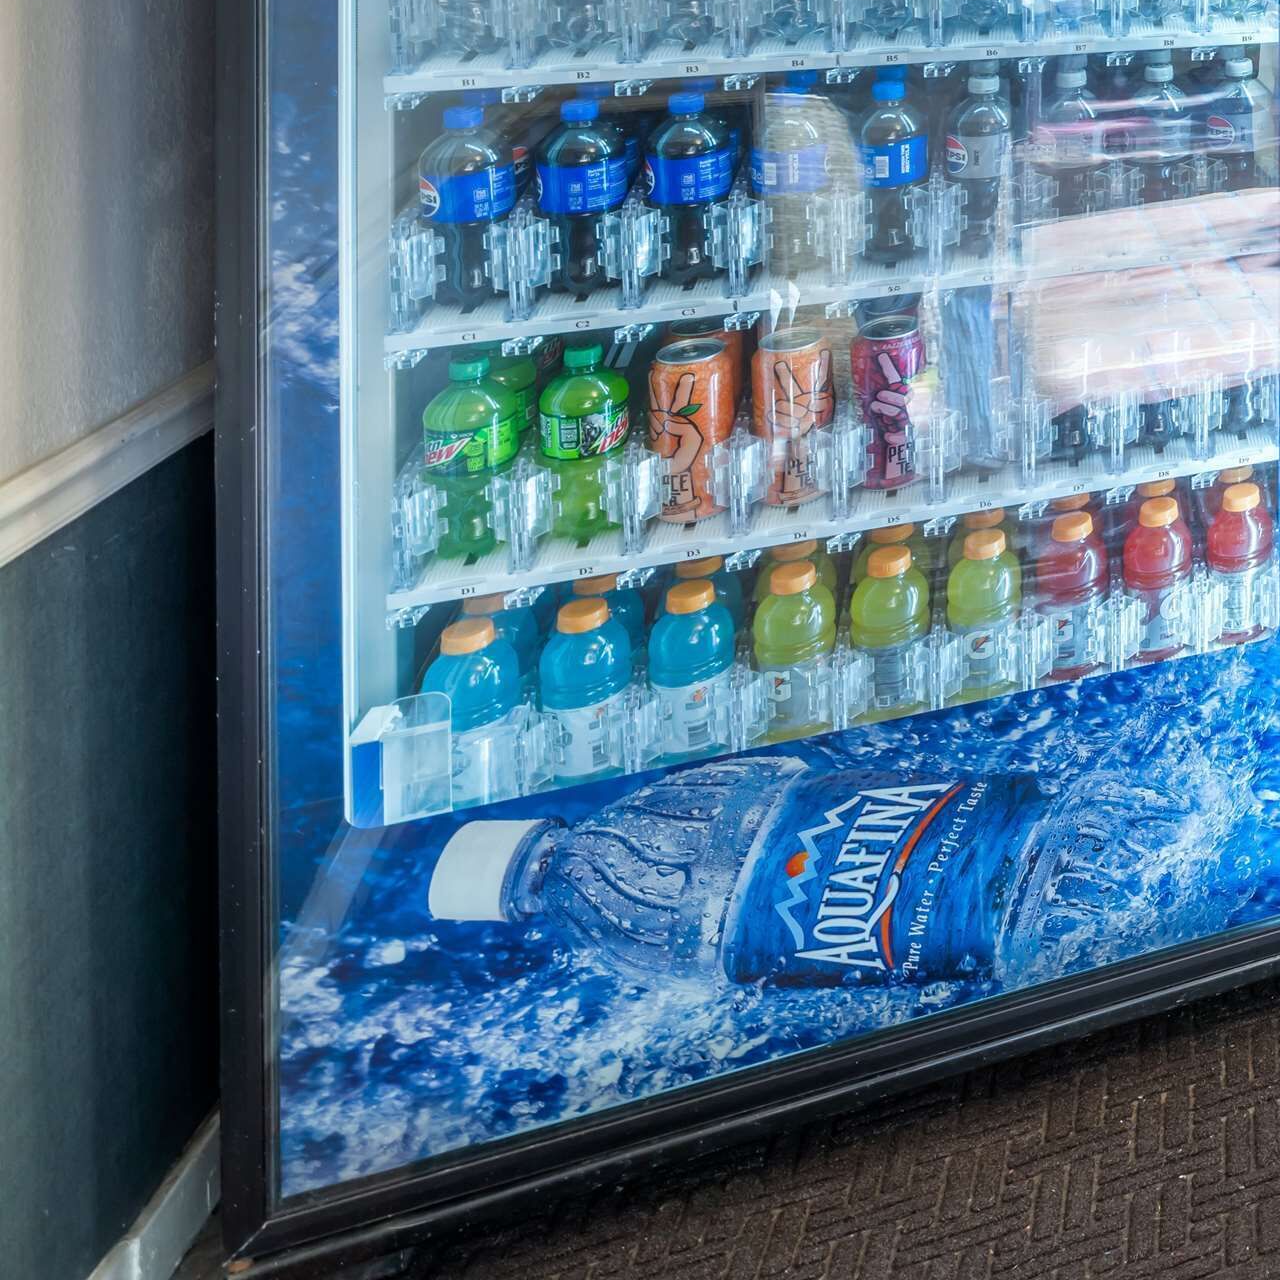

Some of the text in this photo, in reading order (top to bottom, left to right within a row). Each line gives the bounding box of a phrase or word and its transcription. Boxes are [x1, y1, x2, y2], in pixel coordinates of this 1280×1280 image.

[577, 71, 591, 79] B2
[462, 79, 476, 87] B1
[575, 320, 590, 328] C2
[462, 333, 477, 341] C1
[687, 549, 701, 557] D3
[579, 567, 594, 575] D2
[461, 587, 477, 596] D1
[794, 782, 953, 970] AQUAFINA
[902, 779, 988, 975] Pure Water Perfect Taste
